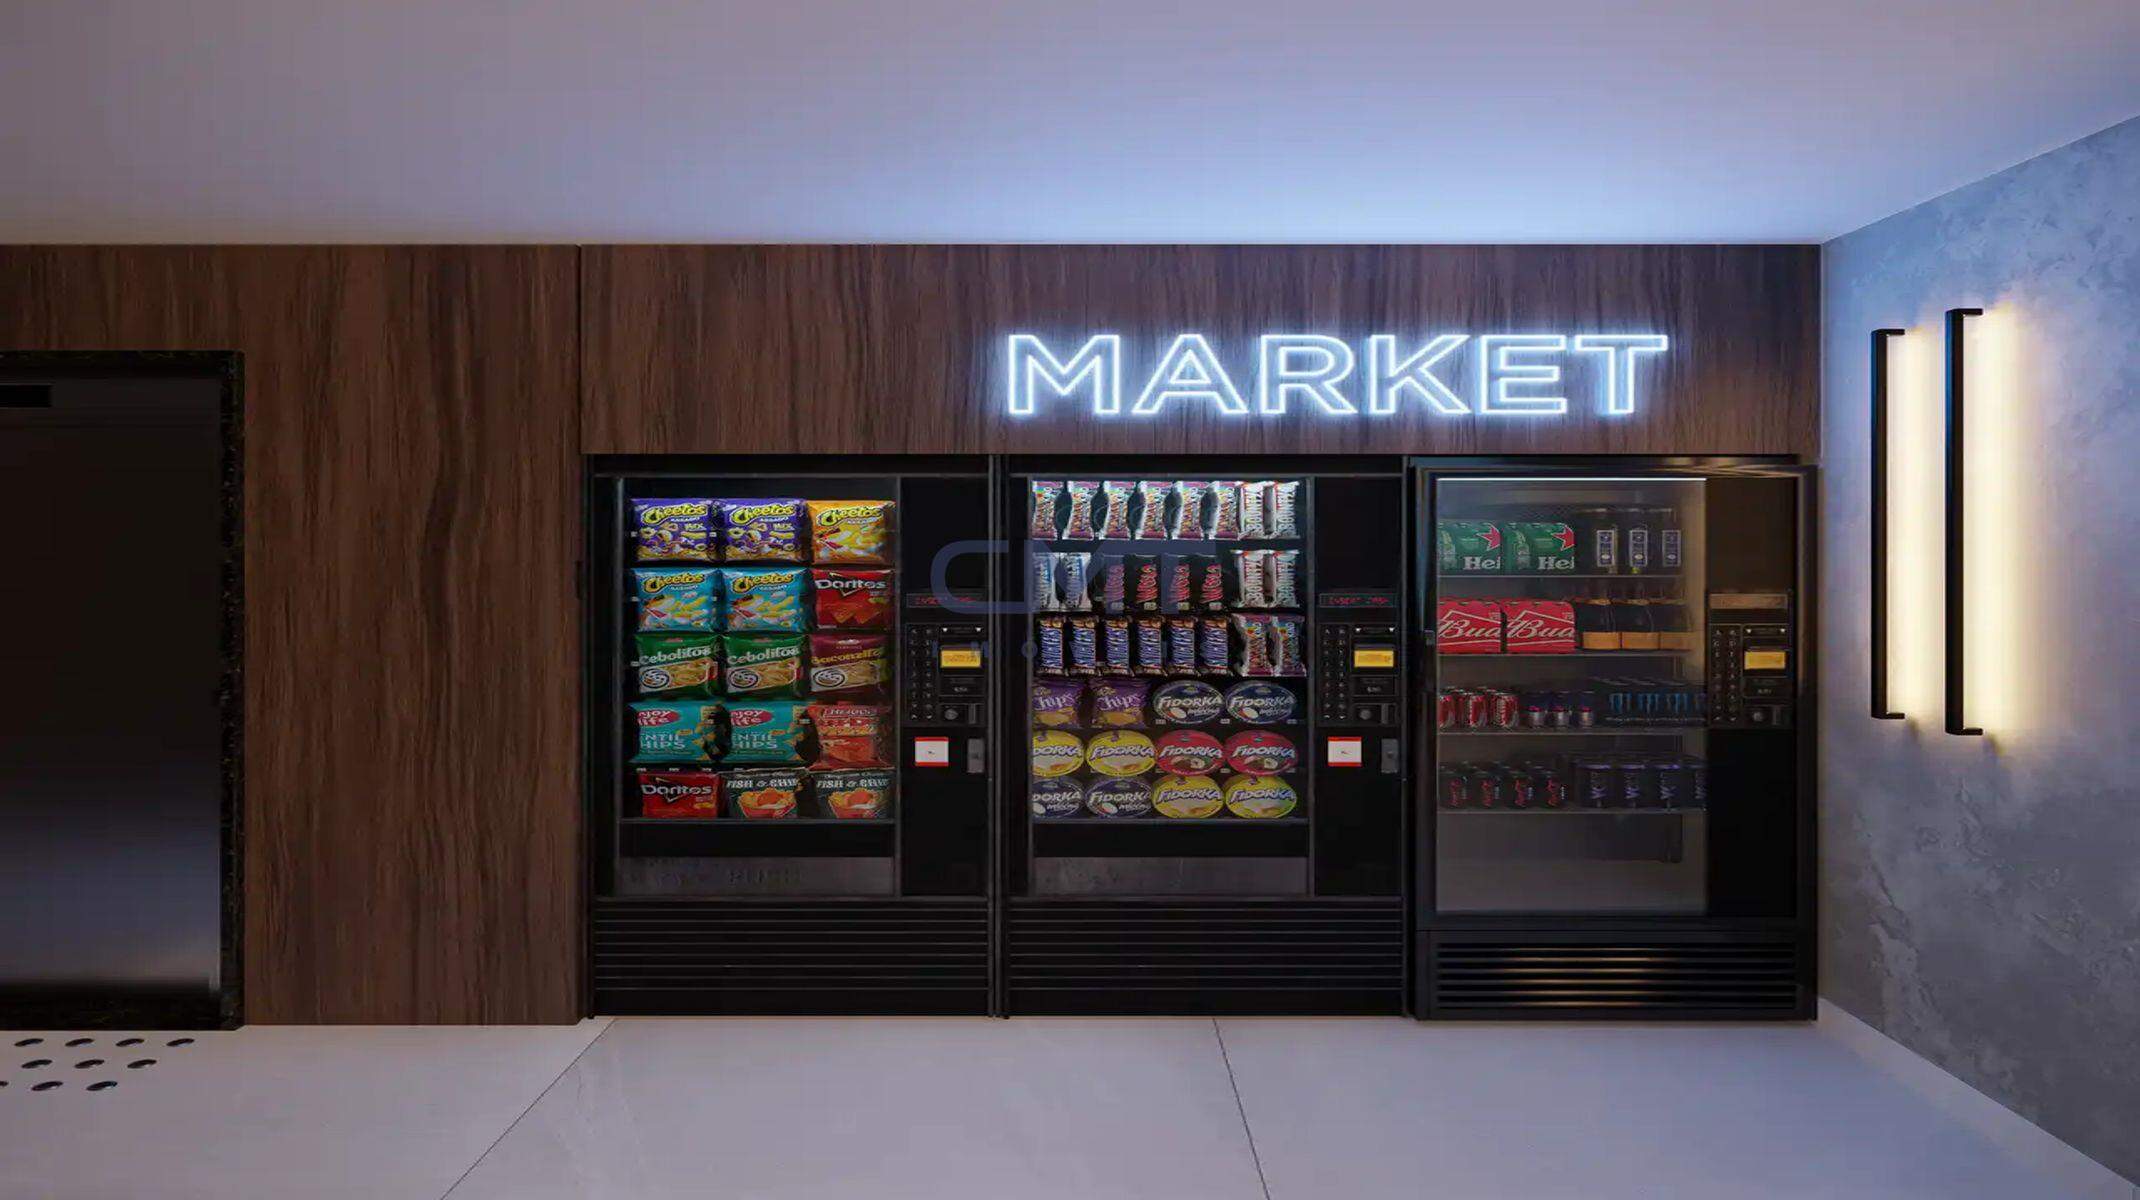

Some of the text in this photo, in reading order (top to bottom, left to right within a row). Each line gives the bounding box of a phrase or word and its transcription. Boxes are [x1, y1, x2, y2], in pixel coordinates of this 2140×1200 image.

[1008, 333, 1668, 415] MARKET
[641, 503, 708, 525] Cheetos
[730, 503, 796, 525] Cheetos
[816, 505, 884, 527] Cheetos
[643, 573, 706, 594] Cheetos
[732, 572, 794, 593] Cheetos
[814, 578, 887, 590] Doritos
[639, 646, 712, 665] Cebolitos
[727, 646, 801, 665] Cebolitos
[638, 710, 671, 719] njoy
[730, 710, 764, 719] njoy
[640, 784, 712, 795] Doritos
